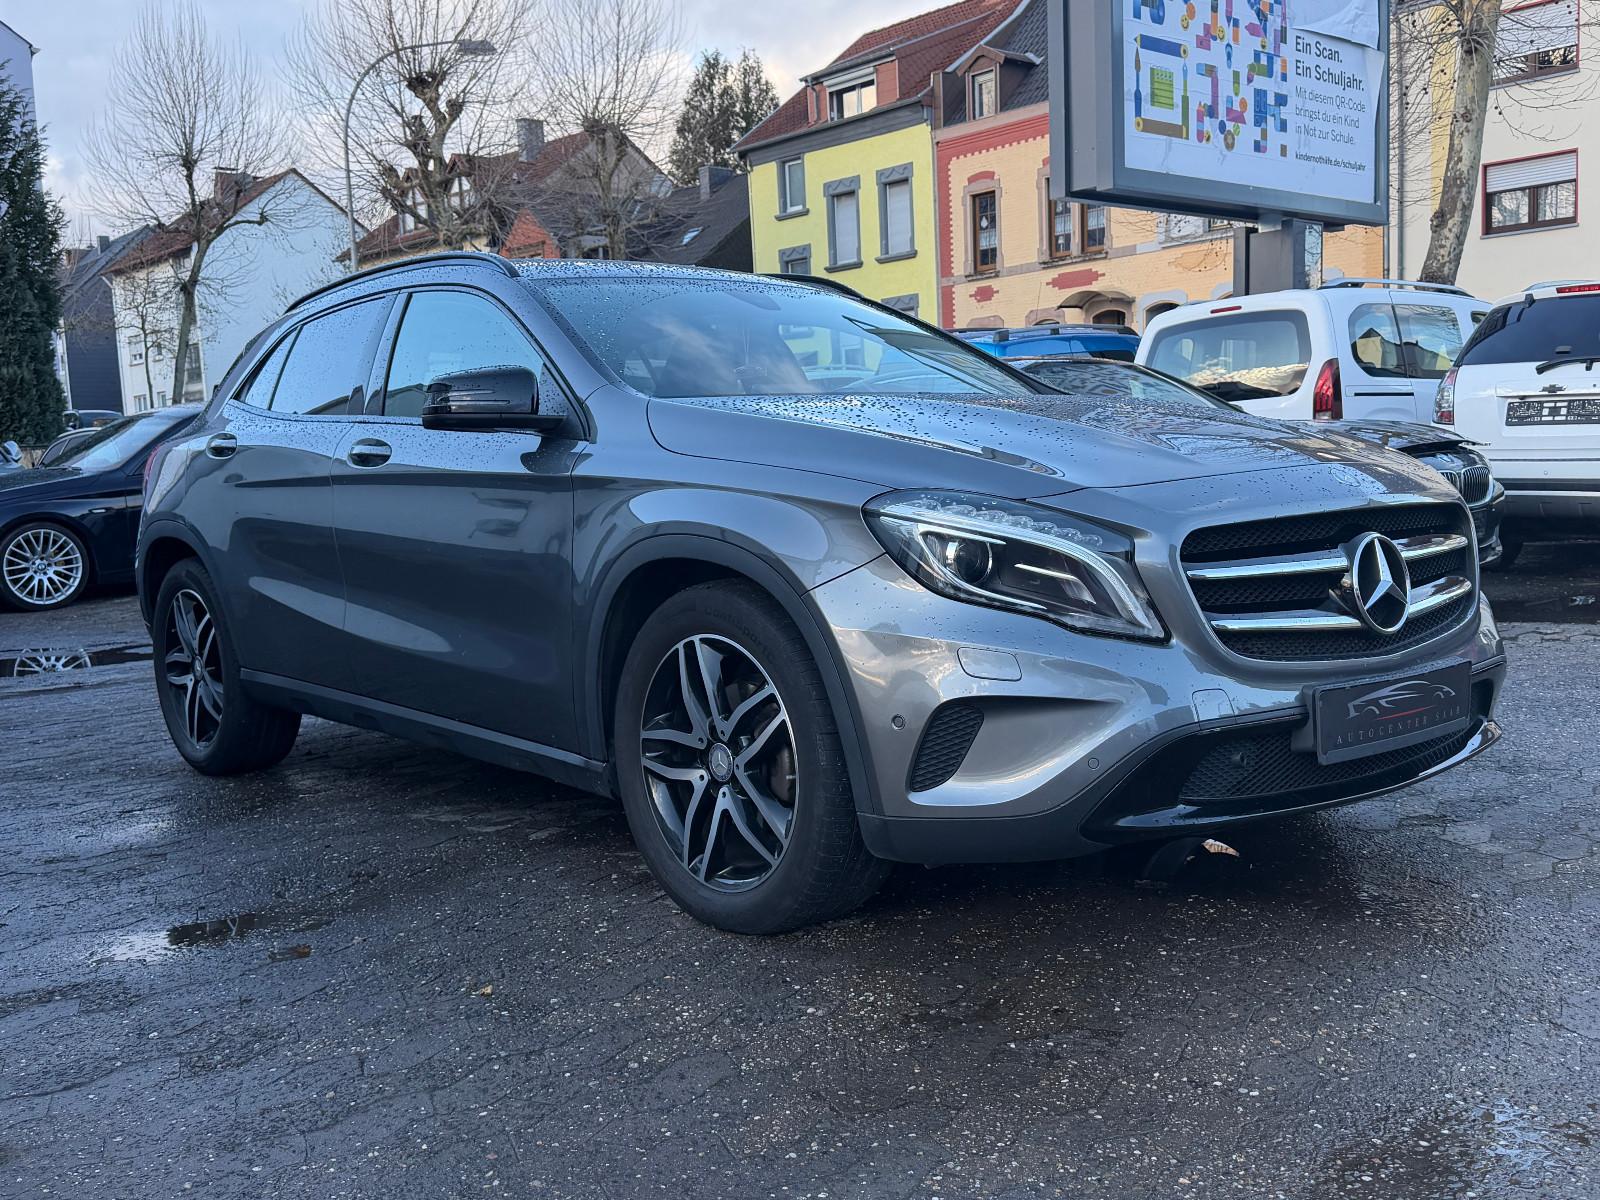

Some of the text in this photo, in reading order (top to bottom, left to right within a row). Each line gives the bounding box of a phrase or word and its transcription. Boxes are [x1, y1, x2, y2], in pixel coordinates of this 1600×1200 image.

[1295, 35, 1343, 63] Ein Scan.
[1295, 59, 1365, 92] Ein Schuljahr.
[1295, 86, 1366, 113] Mit diesem QR-Code
[1295, 105, 1360, 129] bringst du ein Kind
[1295, 123, 1355, 145] in Not zur Schule.
[1337, 716, 1428, 745] AUTOCENTER
